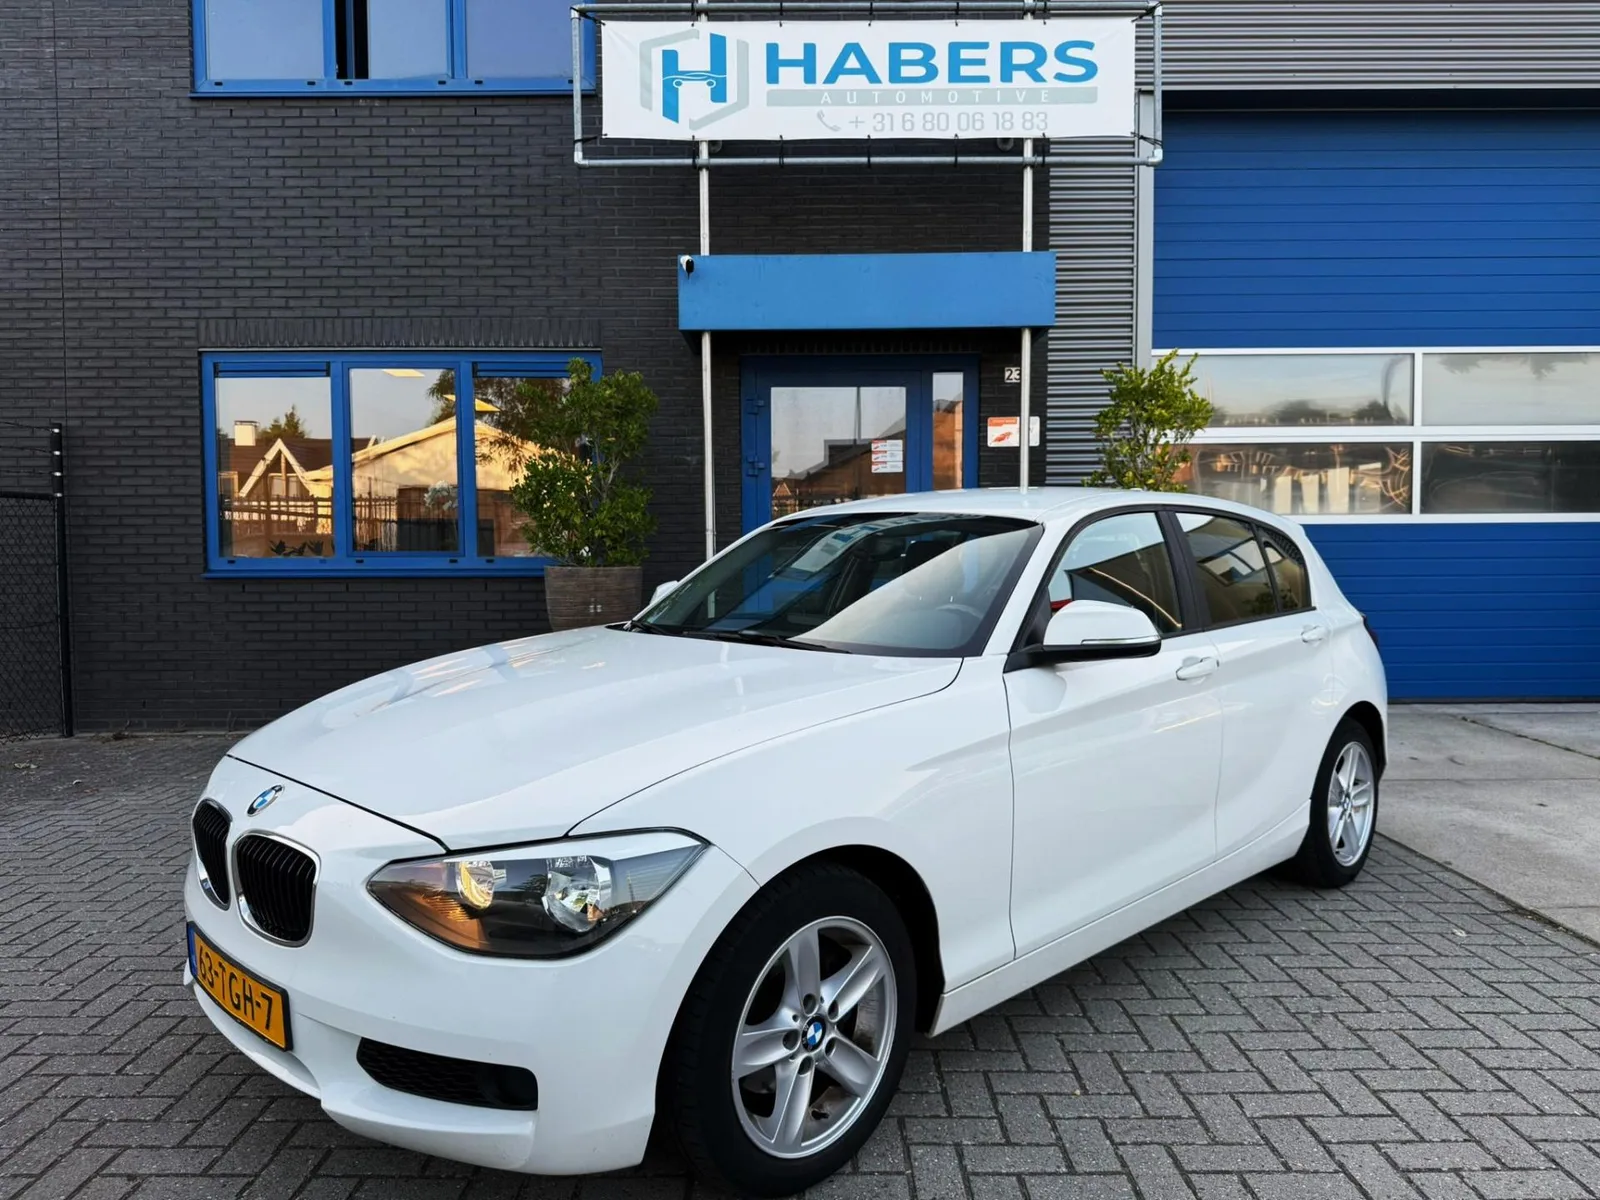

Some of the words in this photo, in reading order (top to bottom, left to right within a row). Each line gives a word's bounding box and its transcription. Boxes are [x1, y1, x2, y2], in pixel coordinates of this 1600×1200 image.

[766, 40, 1099, 84] HABERS
[820, 90, 1049, 105] AUTOMOTIVE
[872, 112, 894, 132] 31
[901, 112, 915, 132] 6
[922, 112, 950, 132] 80
[957, 111, 985, 132] 06
[992, 111, 1015, 131] 18
[1021, 111, 1049, 131] 83
[199, 946, 273, 1030] 63-TGH-7
